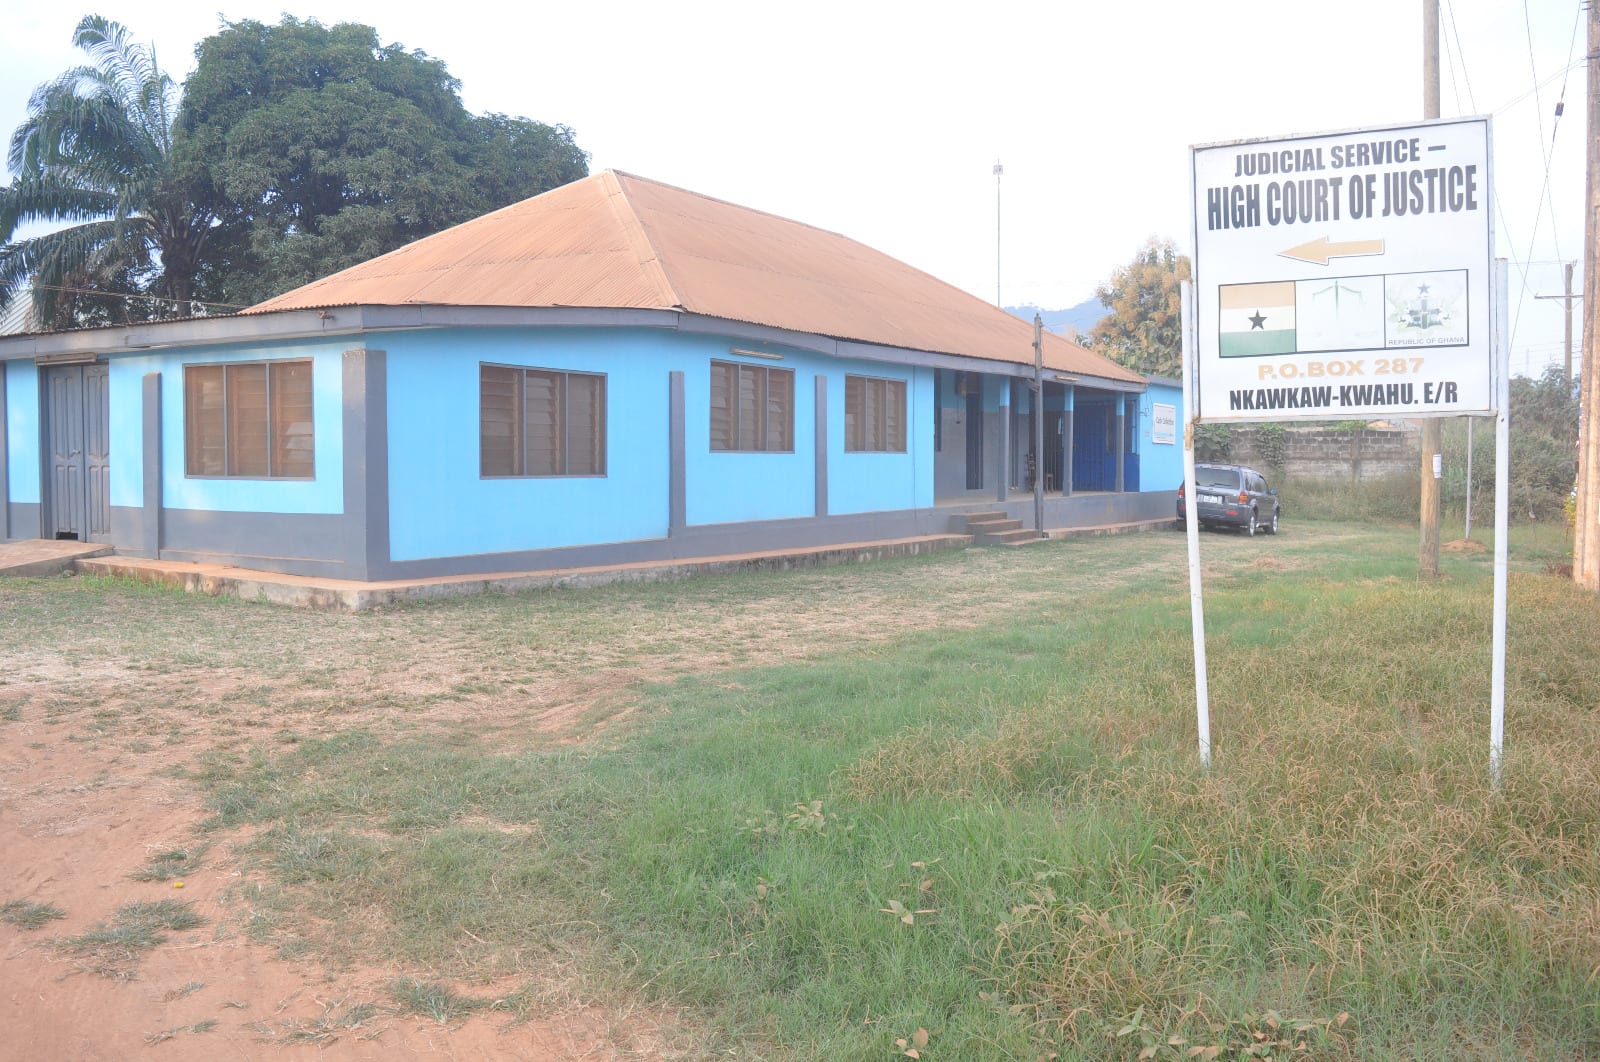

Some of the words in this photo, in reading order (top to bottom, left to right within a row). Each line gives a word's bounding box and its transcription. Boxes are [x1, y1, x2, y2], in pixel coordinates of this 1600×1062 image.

[1235, 148, 1325, 177] JUDICIAL
[1331, 138, 1420, 169] SERVICE
[1208, 184, 1260, 230] HIGH
[1267, 177, 1342, 226] COURT
[1349, 174, 1376, 220] OF
[1382, 165, 1477, 217] JUSTICE
[1374, 358, 1424, 375] 287
